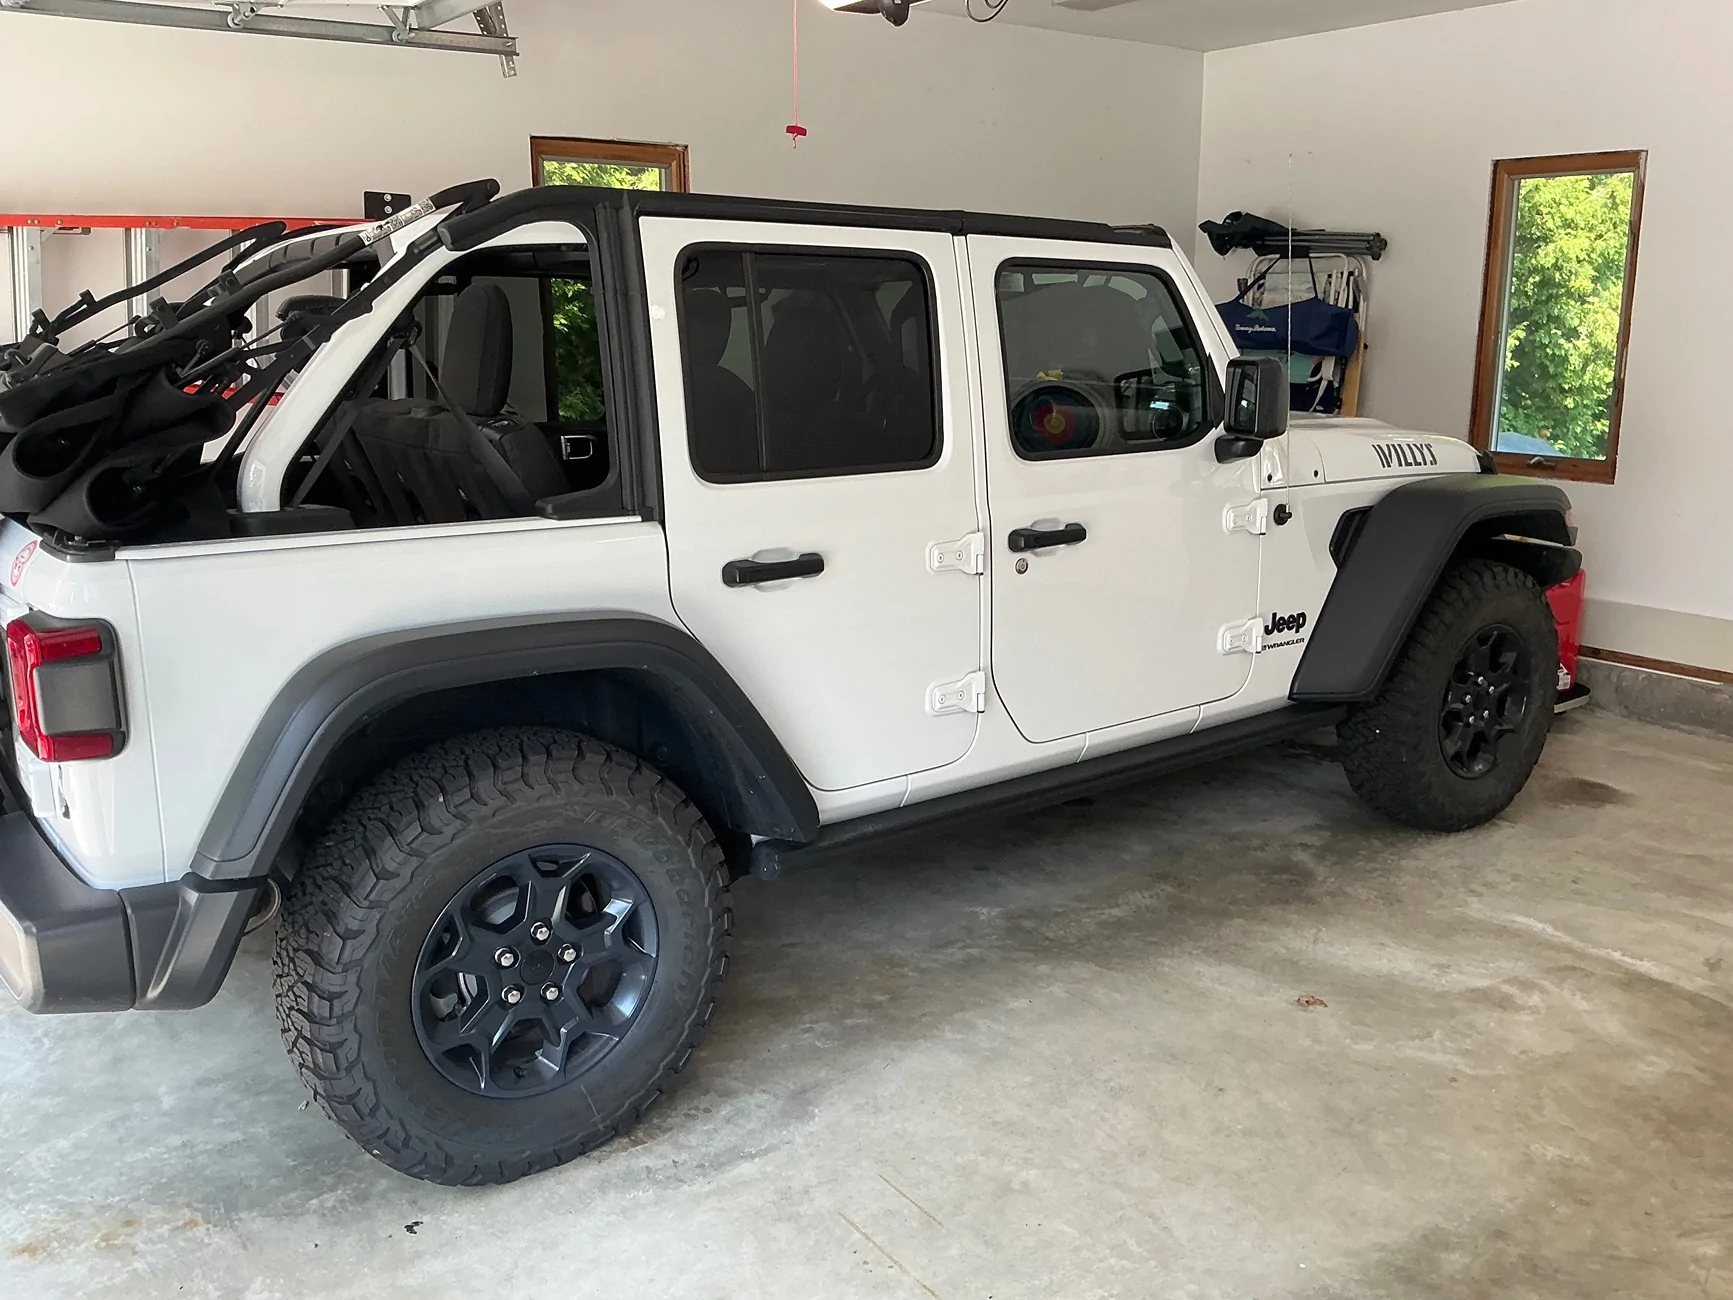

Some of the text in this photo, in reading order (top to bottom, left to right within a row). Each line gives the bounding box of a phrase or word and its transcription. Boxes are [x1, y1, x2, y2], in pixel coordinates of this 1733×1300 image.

[1370, 443, 1438, 468] WILLYS
[1264, 611, 1307, 635] Jeep
[1267, 637, 1305, 650] WRANGLER
